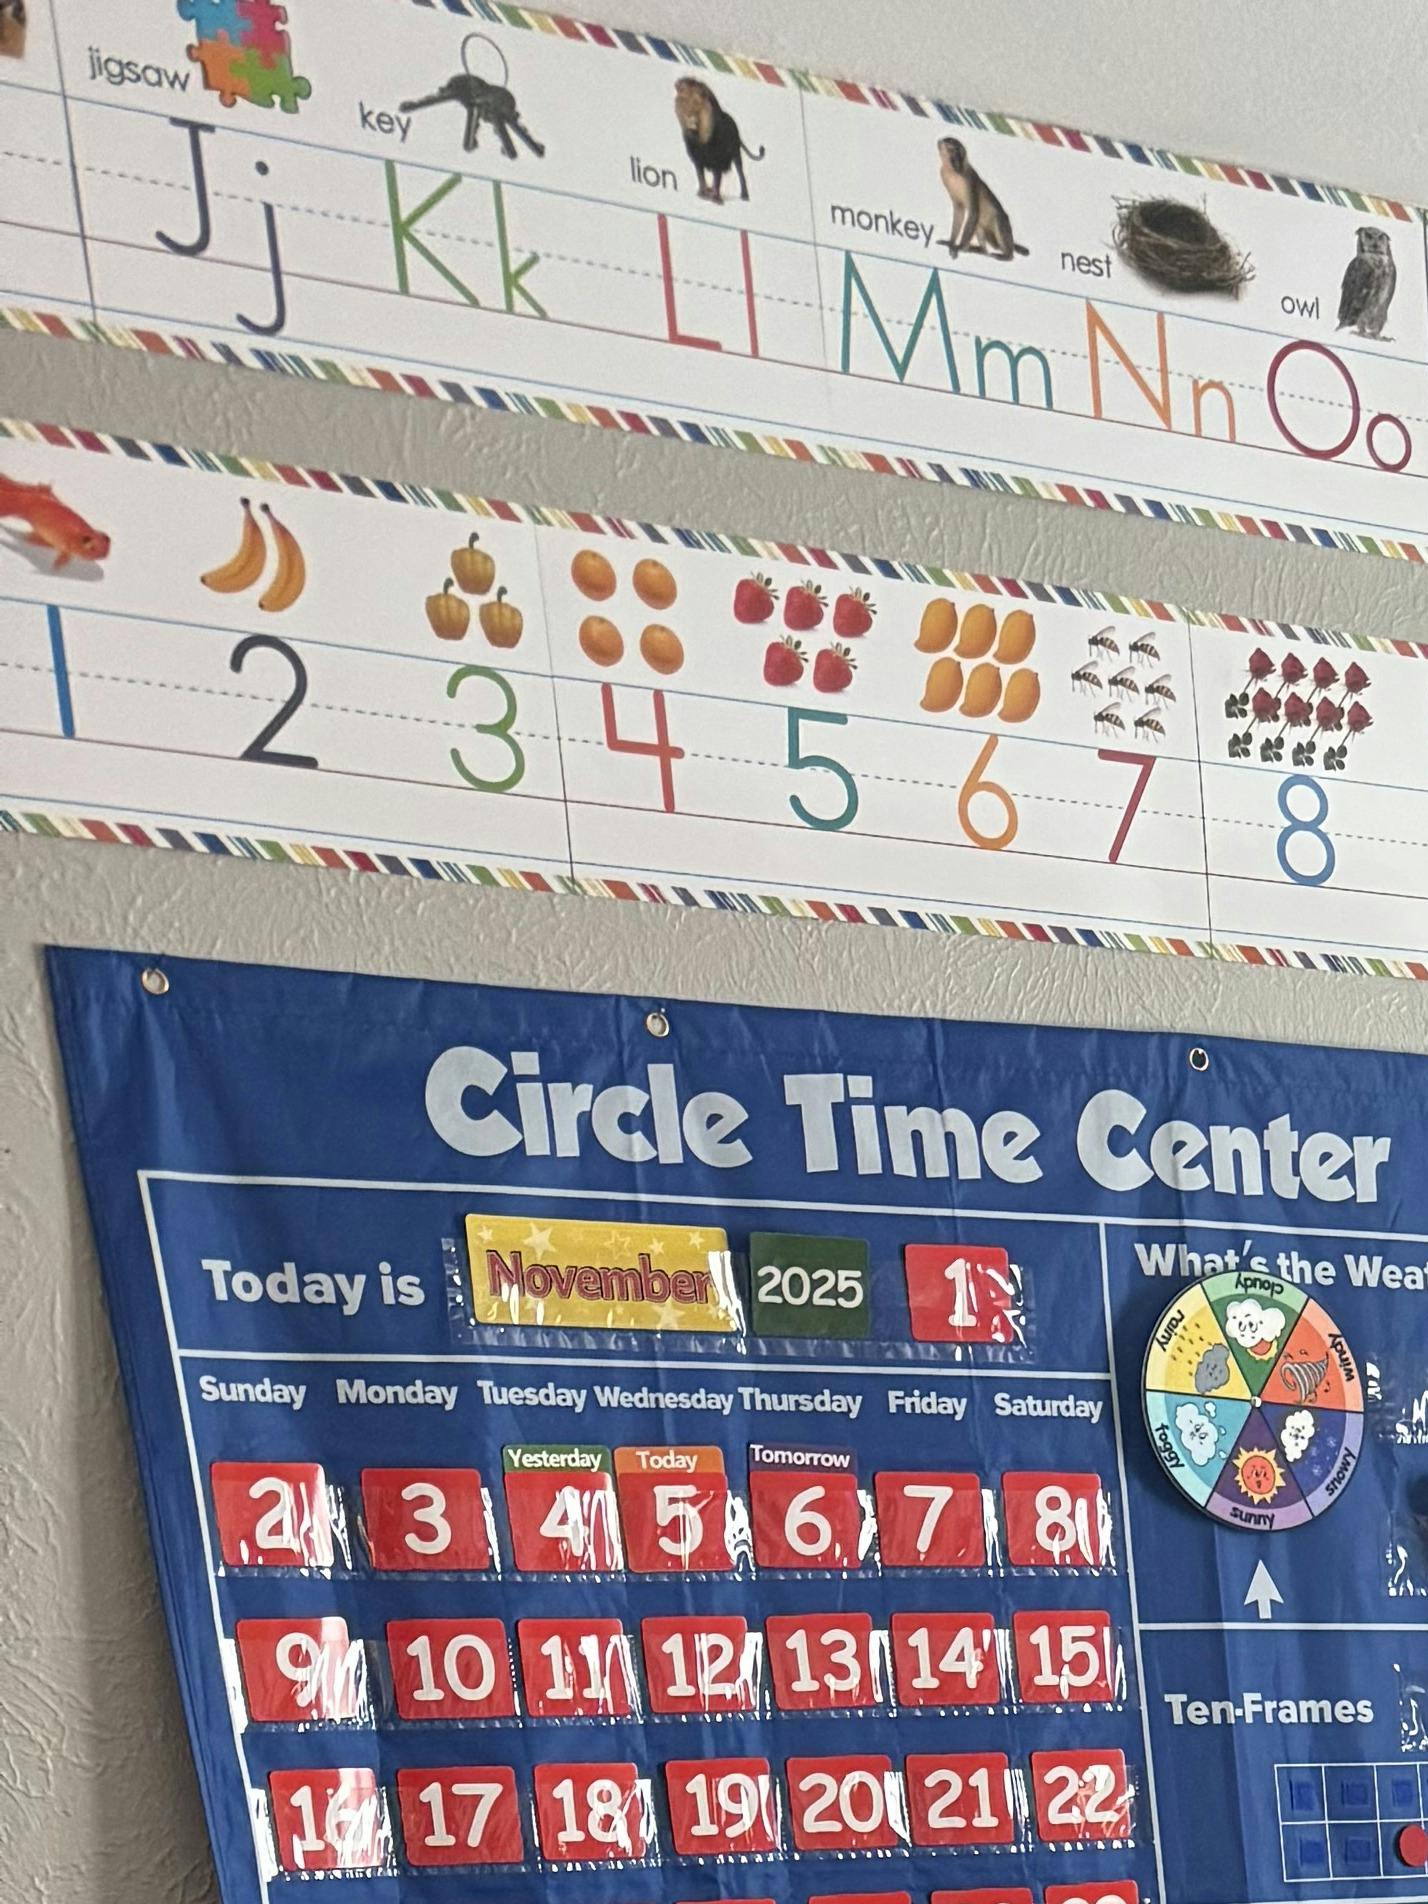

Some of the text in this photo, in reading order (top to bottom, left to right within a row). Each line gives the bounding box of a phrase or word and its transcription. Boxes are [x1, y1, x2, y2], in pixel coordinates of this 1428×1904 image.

[88, 46, 679, 192] jigsaw key lion
[155, 117, 288, 338] Jj
[382, 158, 550, 320] Kk
[830, 203, 1321, 321] monkey nest owl
[840, 248, 1413, 474] Mm Nn Oo
[46, 604, 75, 741] 1
[229, 633, 319, 770] 2
[446, 664, 526, 794] 3
[600, 682, 685, 814] 4
[785, 705, 861, 833] 5
[956, 733, 1019, 852] 6
[1096, 749, 1159, 864] 7
[1276, 773, 1336, 888] 8
[425, 1044, 1392, 1204] Circle Time Center
[201, 1258, 366, 1318] Today
[380, 1261, 425, 1307] is
[486, 1248, 716, 1305] November
[756, 1262, 865, 1311] 2025
[1134, 1238, 1268, 1281] What's
[1276, 1250, 1337, 1288] the
[1235, 1273, 1284, 1296] cloudy
[1154, 1308, 1186, 1353] rainy
[1327, 1332, 1356, 1383] windy
[199, 1375, 1104, 1425] Sunday Monday Tuesday Wednesday Thursday Friday Saturday
[507, 1443, 851, 1473] Yesterday Today Tomorrow
[1154, 1424, 1186, 1470] foggy
[1325, 1447, 1357, 1497] snowy
[248, 1476, 1077, 1557] 2 3 4 5 6 7 8
[1229, 1506, 1275, 1529] sunny
[275, 1624, 1101, 1708] 9 10 11 12 13 14 15
[1164, 1692, 1375, 1726] Ten-Frames
[418, 1780, 504, 1848] 17
[550, 1778, 625, 1845] 18
[684, 1772, 759, 1839] 19
[797, 1769, 885, 1835] 20
[923, 1767, 1001, 1829] 21
[1043, 1763, 1122, 1826] 22
